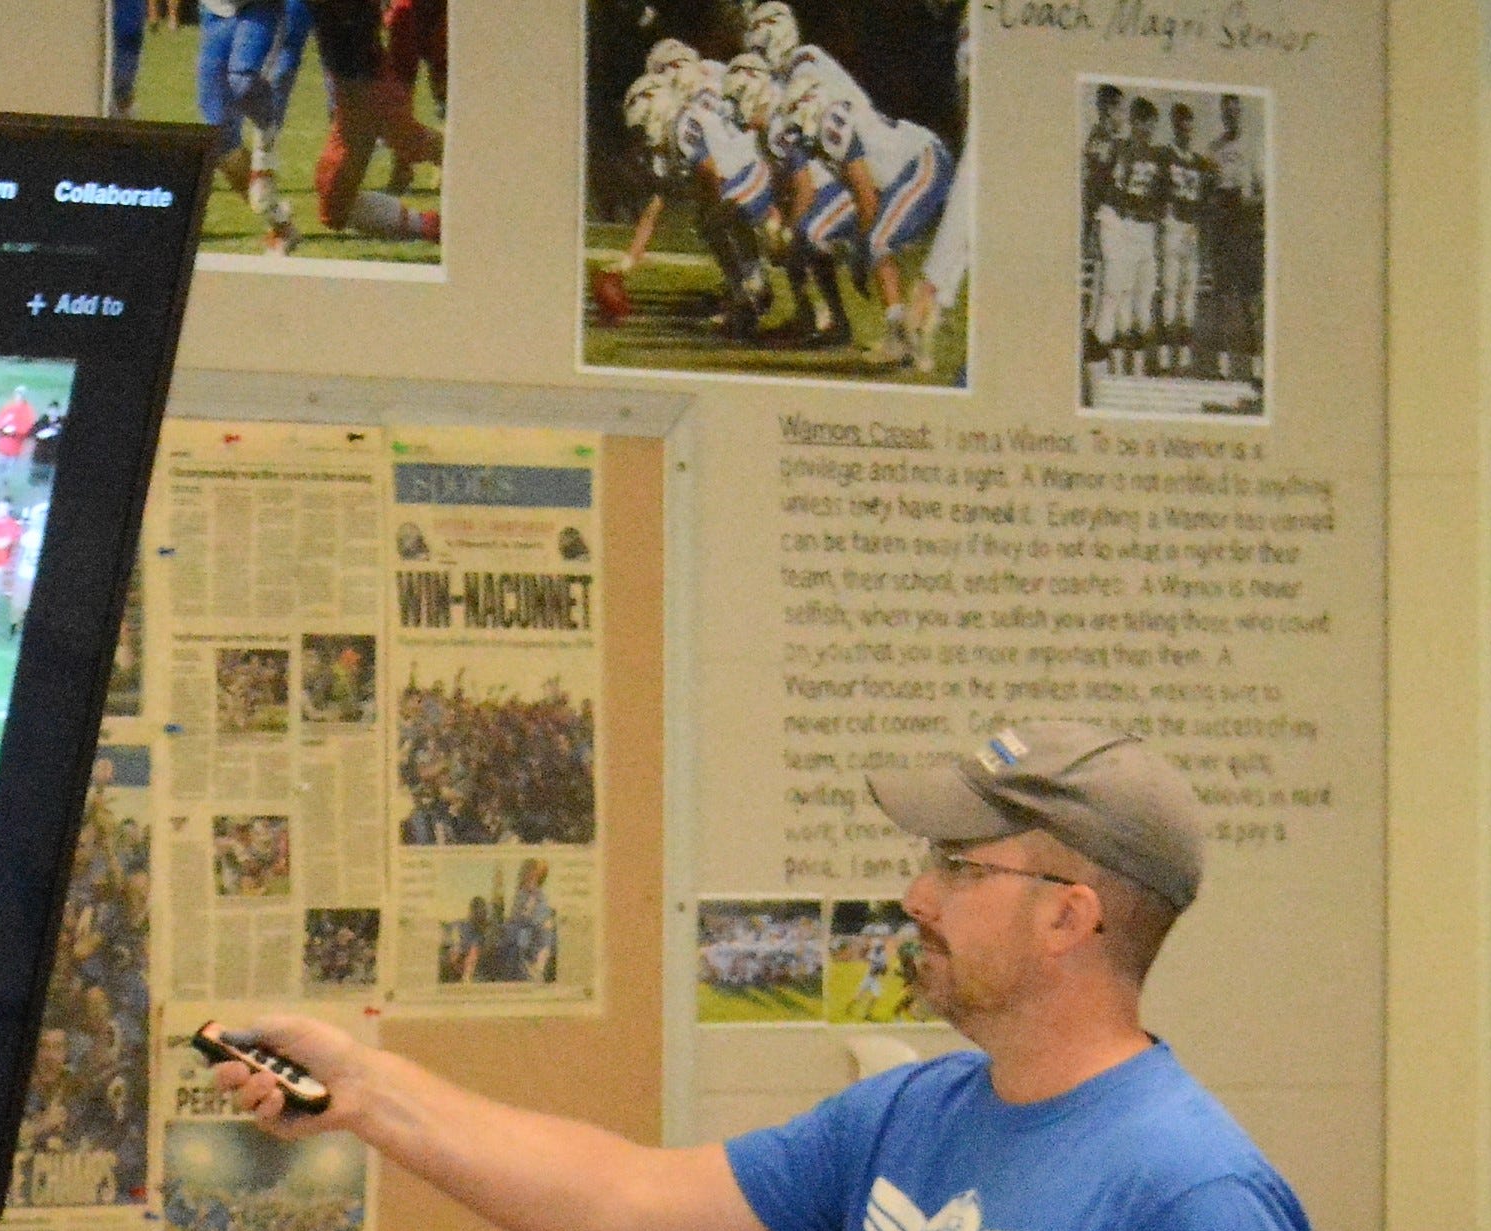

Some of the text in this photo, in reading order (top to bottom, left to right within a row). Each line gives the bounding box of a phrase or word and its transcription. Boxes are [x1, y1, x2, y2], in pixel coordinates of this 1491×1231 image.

[55, 181, 175, 208] Collaborate
[55, 293, 124, 316] Add to
